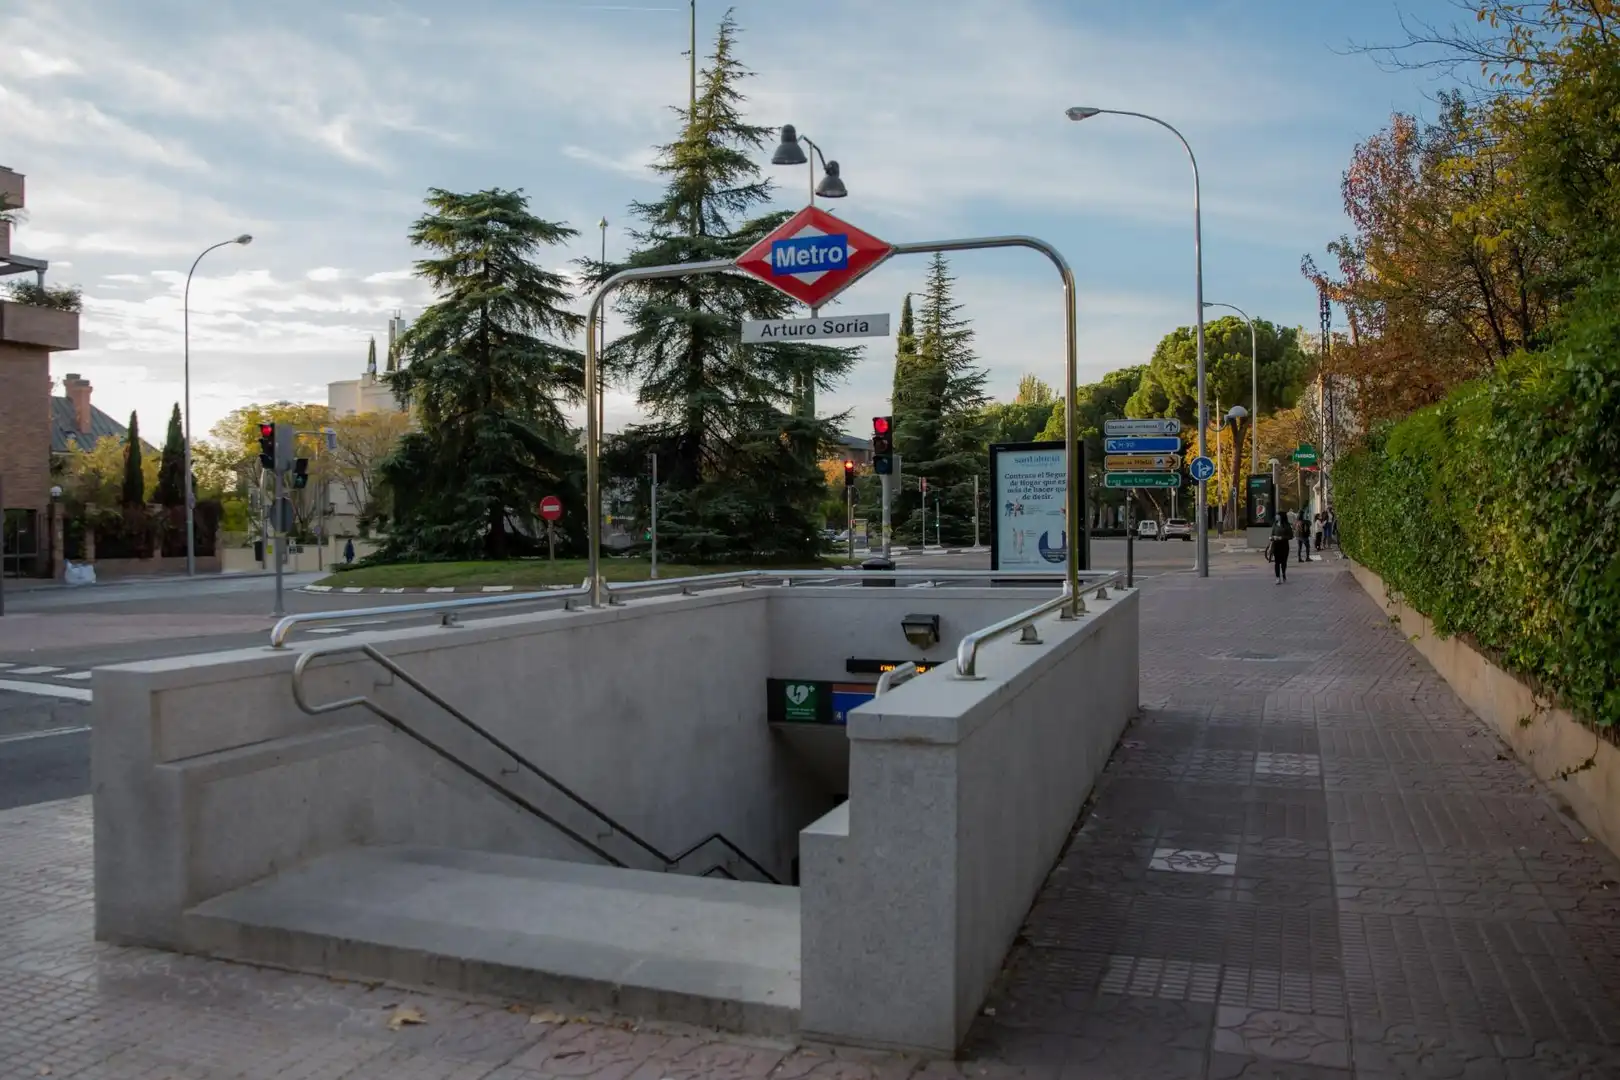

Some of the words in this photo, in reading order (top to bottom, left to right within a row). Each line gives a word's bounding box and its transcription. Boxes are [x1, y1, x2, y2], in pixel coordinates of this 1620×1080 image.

[776, 245, 843, 268] Metro
[760, 324, 816, 337] Arturo
[823, 319, 869, 334] Soria
[1020, 480, 1041, 488] Hogar
[1042, 480, 1056, 488] que
